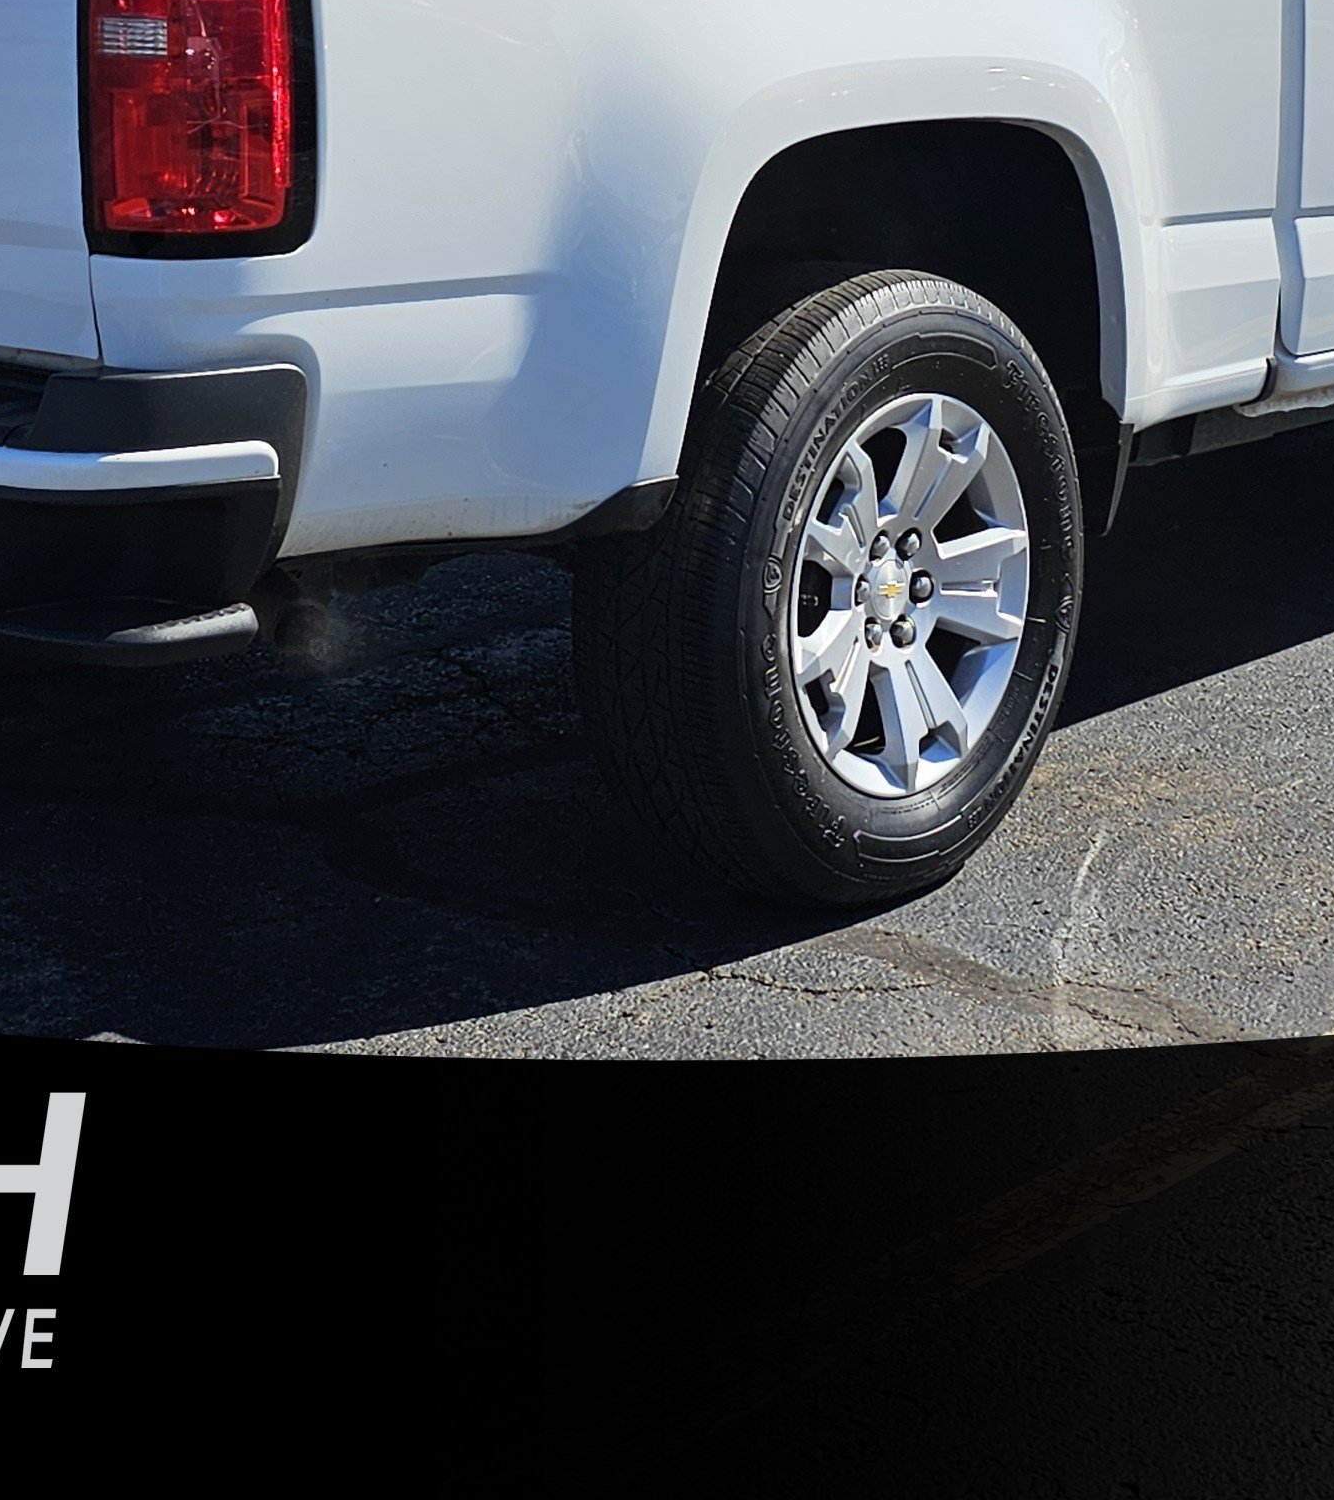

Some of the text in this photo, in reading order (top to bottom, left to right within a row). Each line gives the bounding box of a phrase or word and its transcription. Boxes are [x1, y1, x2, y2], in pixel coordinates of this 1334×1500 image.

[783, 367, 875, 521] DESTINATION
[1003, 359, 1075, 561] Firestone
[761, 632, 847, 848] Firestone
[983, 663, 1059, 810] DESTINATION
